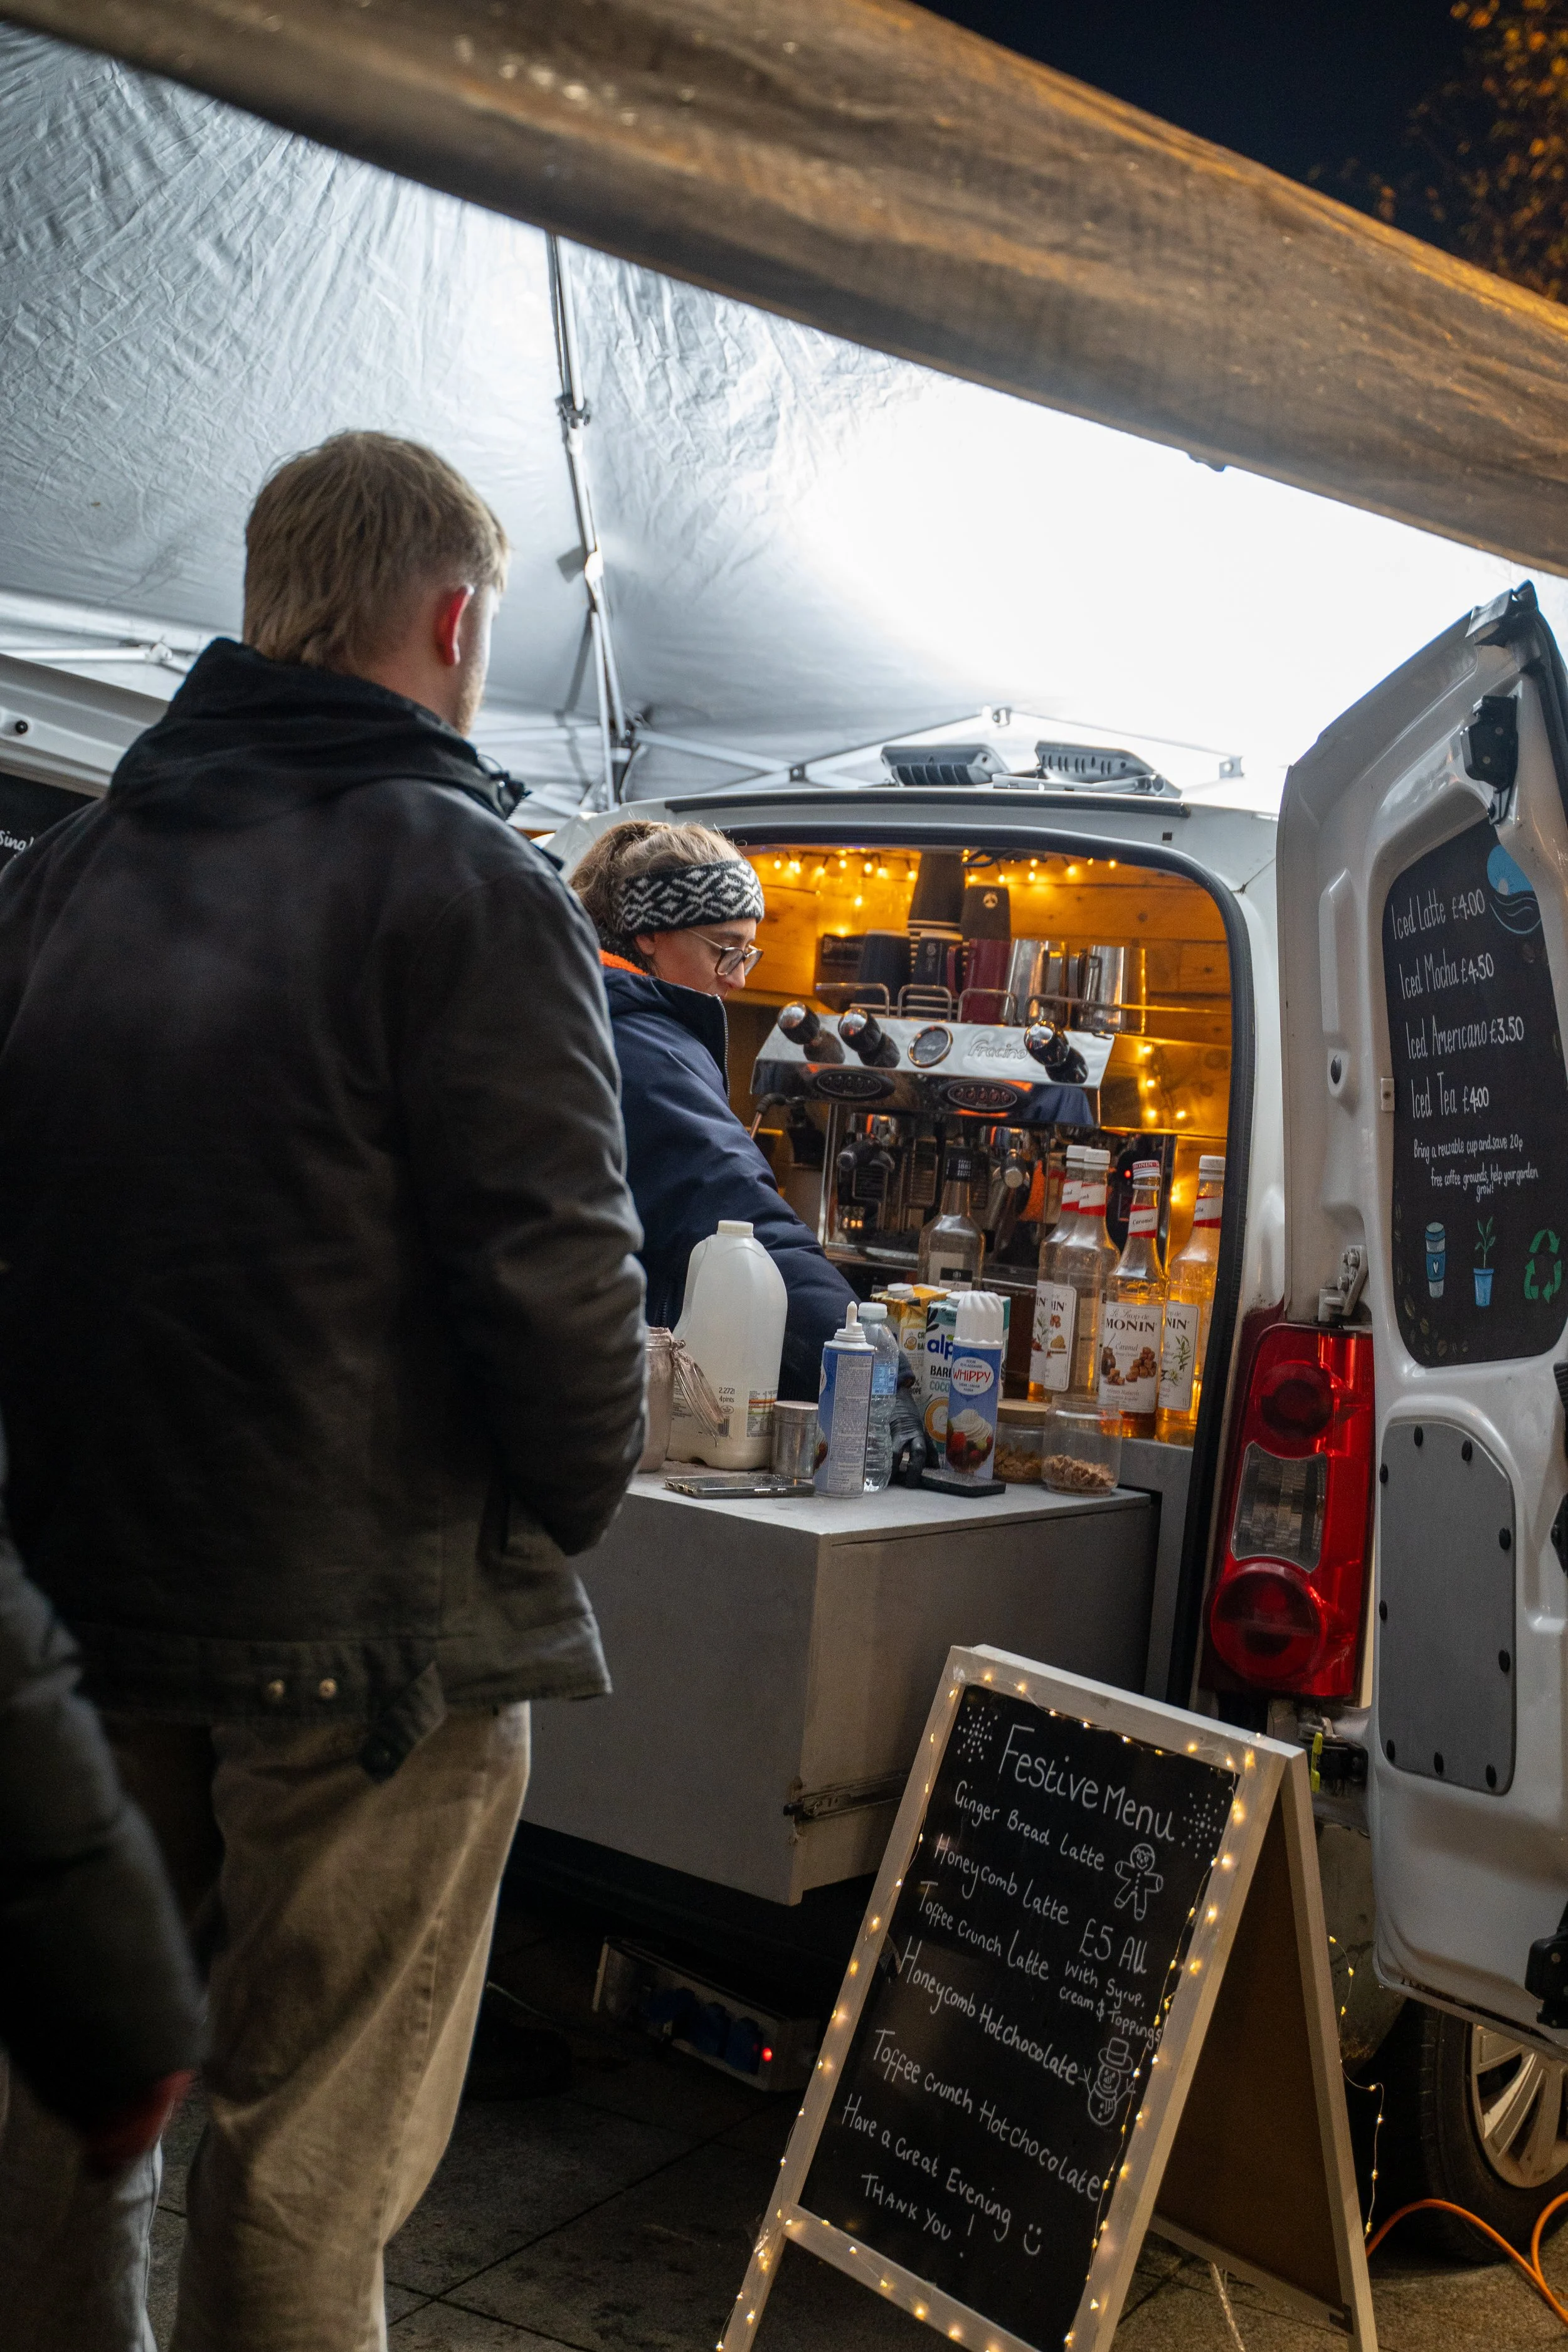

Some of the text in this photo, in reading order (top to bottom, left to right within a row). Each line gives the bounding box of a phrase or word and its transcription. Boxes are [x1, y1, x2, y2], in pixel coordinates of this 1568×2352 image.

[1391, 887, 1486, 940] Iced Latte £4.00
[1399, 948, 1495, 1000] Iced Mocha £4.50
[968, 1039, 1028, 1060] Fracino
[1406, 1014, 1524, 1059] Iced Americano £3.50
[1411, 1076, 1433, 1119] Iced
[1437, 1071, 1458, 1116] Tea
[1414, 1133, 1523, 1165] Bring a reusable cup and save 20p
[1431, 1161, 1539, 1191] free coffee grounds, help your garden
[1476, 1182, 1494, 1203] grow!
[1132, 1217, 1153, 1225] Caramel
[1106, 1318, 1155, 1333] MONIN
[1167, 1316, 1187, 1330] NIN
[928, 1334, 953, 1360] alp
[1115, 1341, 1139, 1351] Caramel
[930, 1365, 951, 1377] BARI
[999, 1724, 1099, 1808] Festive
[955, 1781, 1104, 1871] Ginger Bread Latte
[934, 1833, 1069, 1925] Honeycomb Latte
[919, 1880, 953, 1930] Toffee
[1007, 1930, 1049, 1980] Latte
[1079, 1919, 1147, 1974] £5 All
[899, 1936, 976, 2015] Honeycomb
[1108, 2010, 1163, 2050] Toppings
[873, 2028, 921, 2084] Toffee
[842, 2093, 1012, 2242] Have a Great Evening
